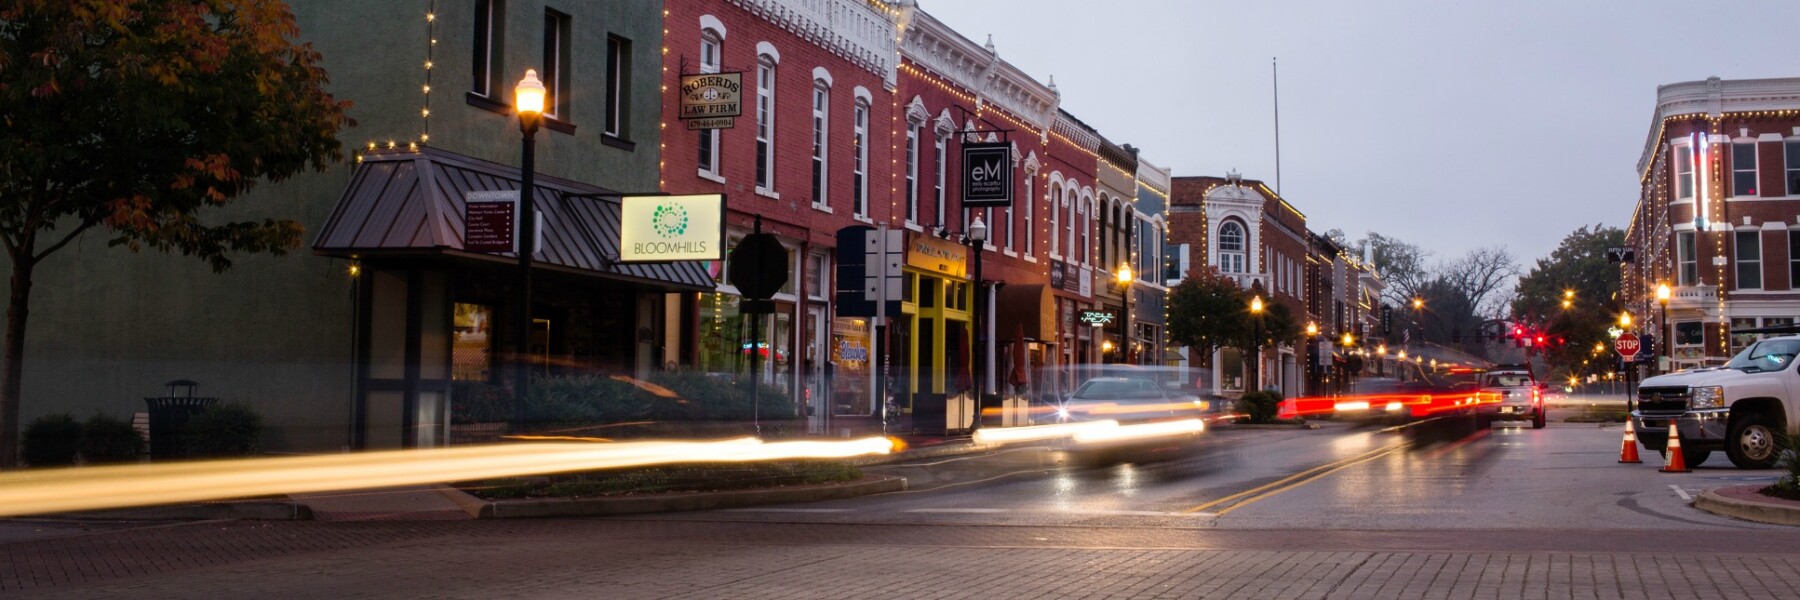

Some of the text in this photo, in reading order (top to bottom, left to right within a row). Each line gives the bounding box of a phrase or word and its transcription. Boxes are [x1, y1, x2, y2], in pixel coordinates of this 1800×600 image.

[683, 77, 739, 95] ROBERDS
[684, 104, 737, 114] LAW FIRM
[972, 159, 1001, 181] eM
[468, 191, 513, 199] DOWNTOWN
[634, 241, 706, 254] BLOOMHILLS
[1616, 340, 1638, 349] STOP
